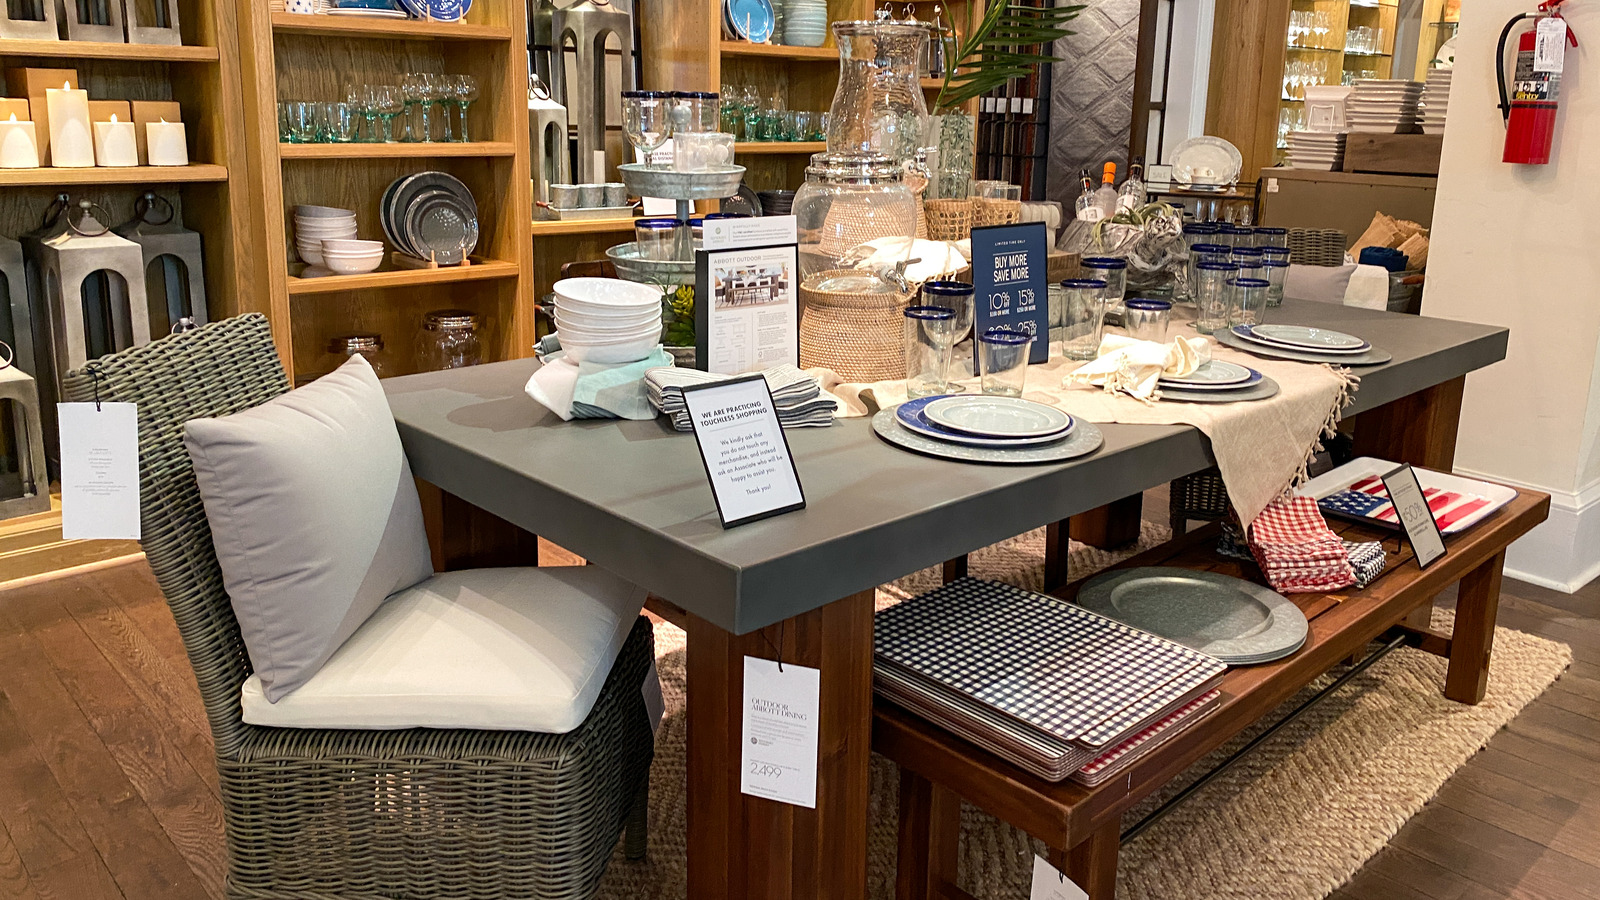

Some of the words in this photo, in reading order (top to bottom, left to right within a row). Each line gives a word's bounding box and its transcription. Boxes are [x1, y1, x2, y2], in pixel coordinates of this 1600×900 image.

[995, 256, 1008, 269] BUY
[1009, 254, 1028, 267] MORE
[994, 269, 1010, 283] SAVE
[1011, 267, 1029, 280] MORE
[989, 292, 1011, 310] 10%
[1018, 289, 1035, 306] 15%
[727, 401, 762, 414] PRACTICING
[701, 415, 735, 427] TOUCHLESS
[736, 408, 768, 420] SHOPPING
[719, 455, 750, 466] merchandise,
[760, 447, 776, 456] instead
[735, 463, 756, 472] Associate
[731, 474, 746, 483] happy
[762, 484, 771, 492] you!
[752, 697, 789, 711] OUTDOOR
[752, 705, 780, 715] ABBOTT
[782, 710, 807, 720] DINING
[751, 762, 782, 779] 2,499
